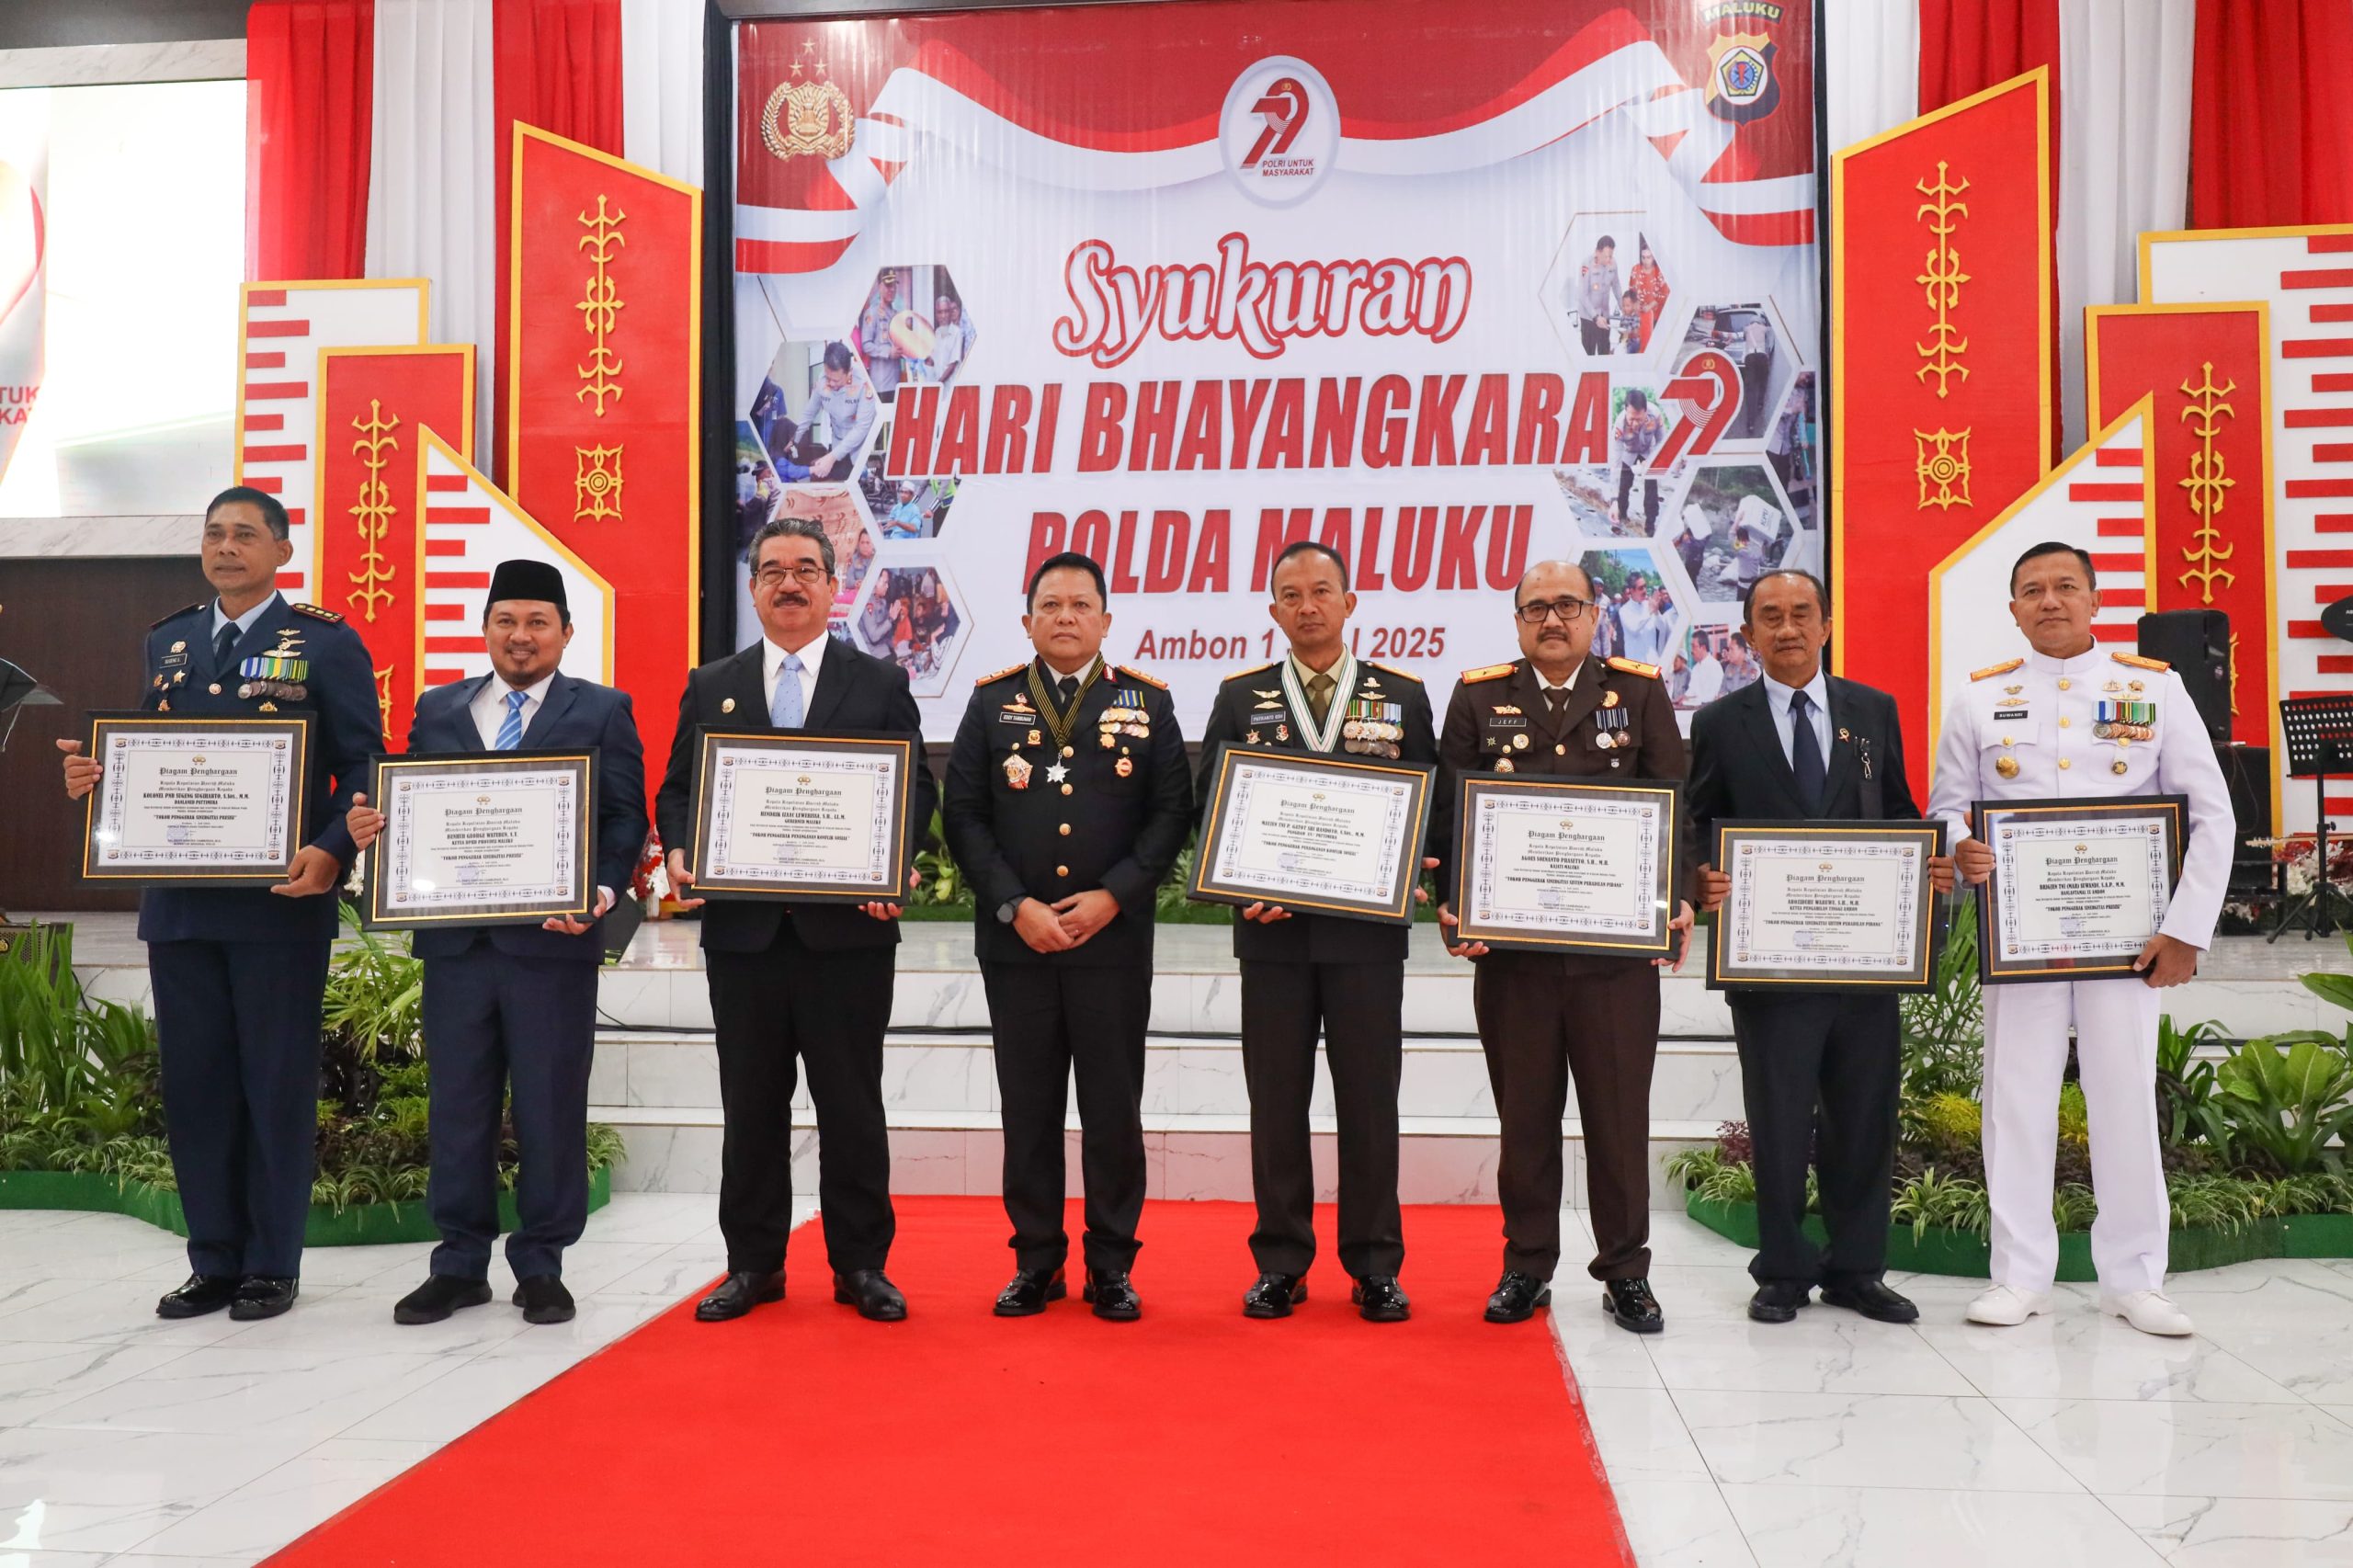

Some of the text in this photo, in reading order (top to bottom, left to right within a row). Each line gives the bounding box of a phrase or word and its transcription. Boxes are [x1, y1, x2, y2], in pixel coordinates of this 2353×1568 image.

[1704, 2, 1780, 23] MALUKU
[1262, 158, 1314, 168] POLRI UNTUK
[1262, 167, 1315, 177] MASYARAKAT
[1052, 232, 1472, 369] Syukuran
[887, 371, 1609, 477] HARI BHAYANGKARA
[1022, 505, 1534, 595] POLDA MALUKU
[1134, 629, 1247, 661] Ambon
[1261, 629, 1275, 659] 1
[1370, 627, 1446, 659] 2025
[796, 788, 841, 796] Penghargaan
[1558, 832, 1605, 841] Penghargaan
[1787, 874, 1813, 882] Piagam
